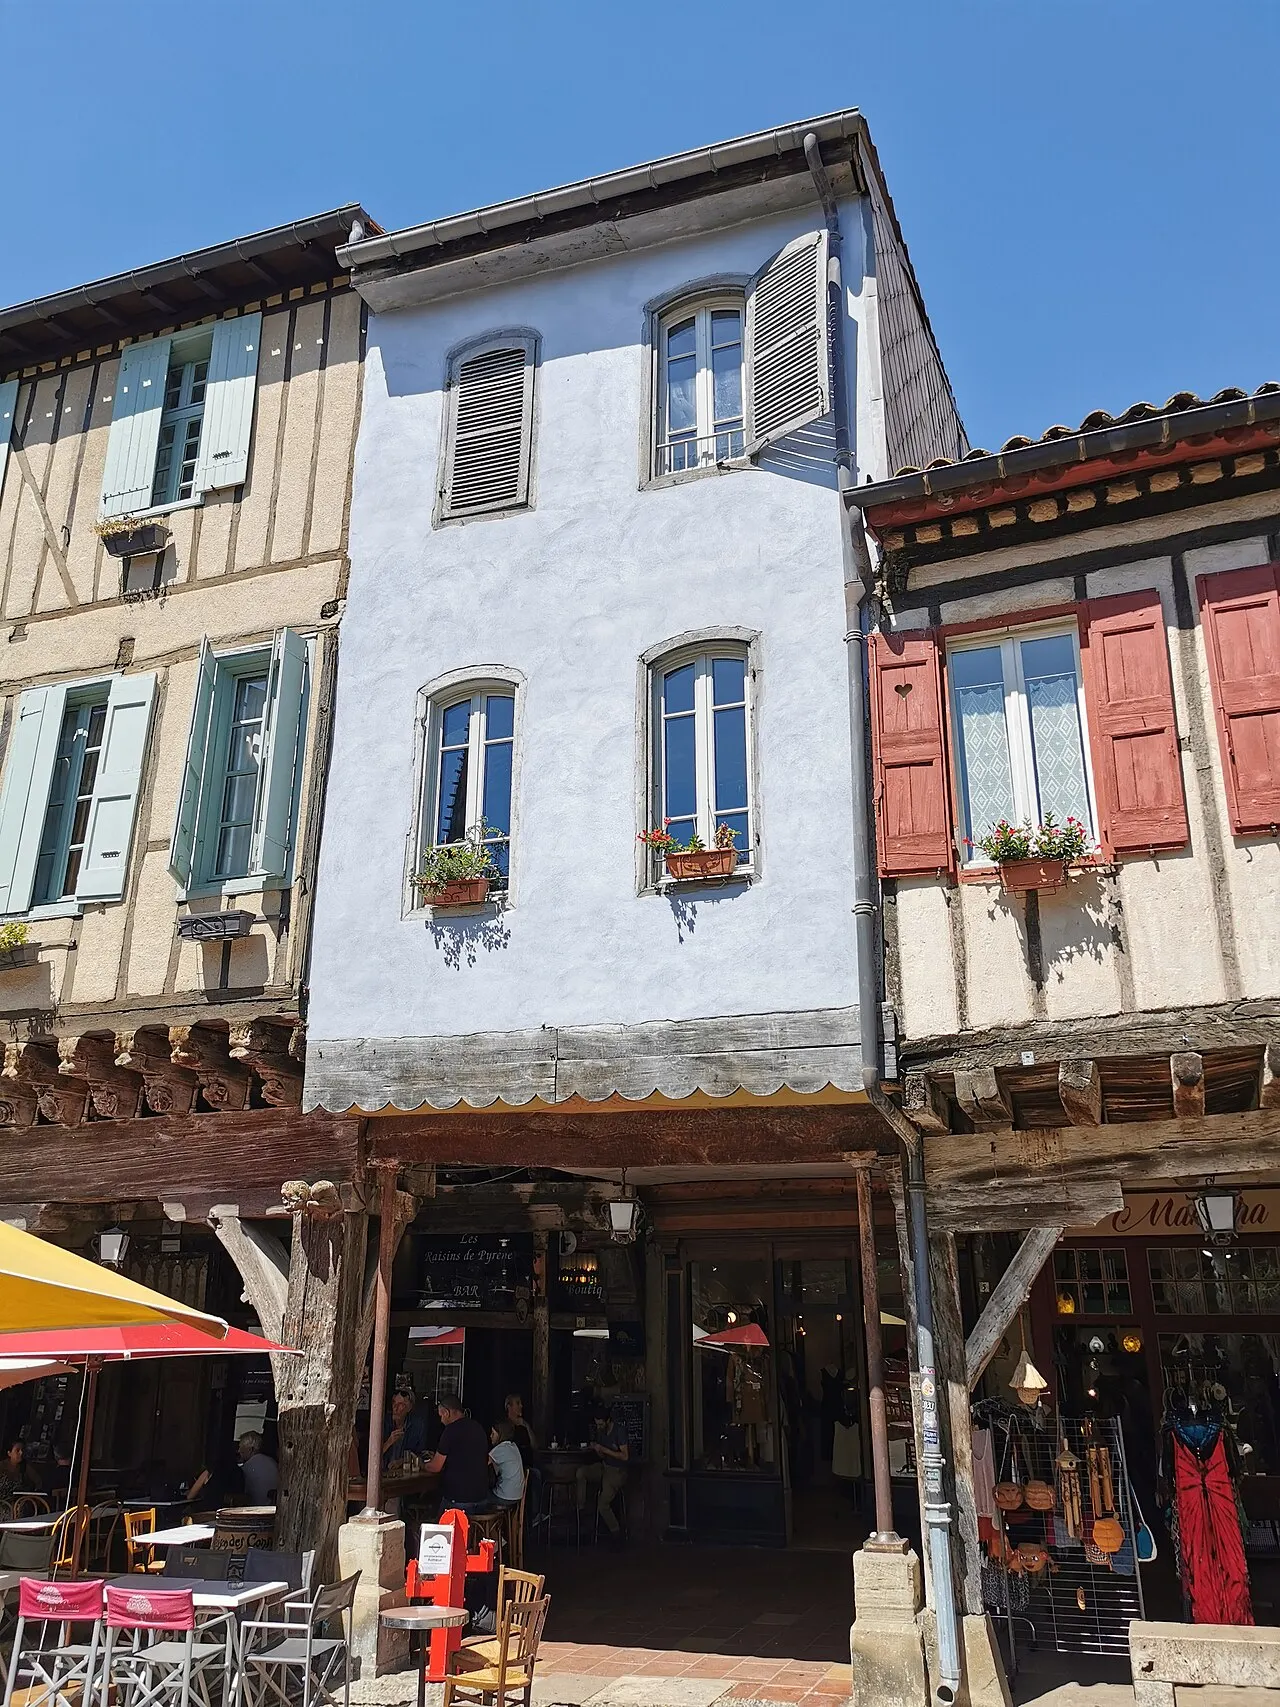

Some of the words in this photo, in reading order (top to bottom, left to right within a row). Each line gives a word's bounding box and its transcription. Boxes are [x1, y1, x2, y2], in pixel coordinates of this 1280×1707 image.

[1112, 1196, 1269, 1232] Mara
[459, 1233, 478, 1244] Les
[424, 1250, 461, 1264] Raisins
[463, 1248, 475, 1261] de
[453, 1285, 480, 1297] BAR
